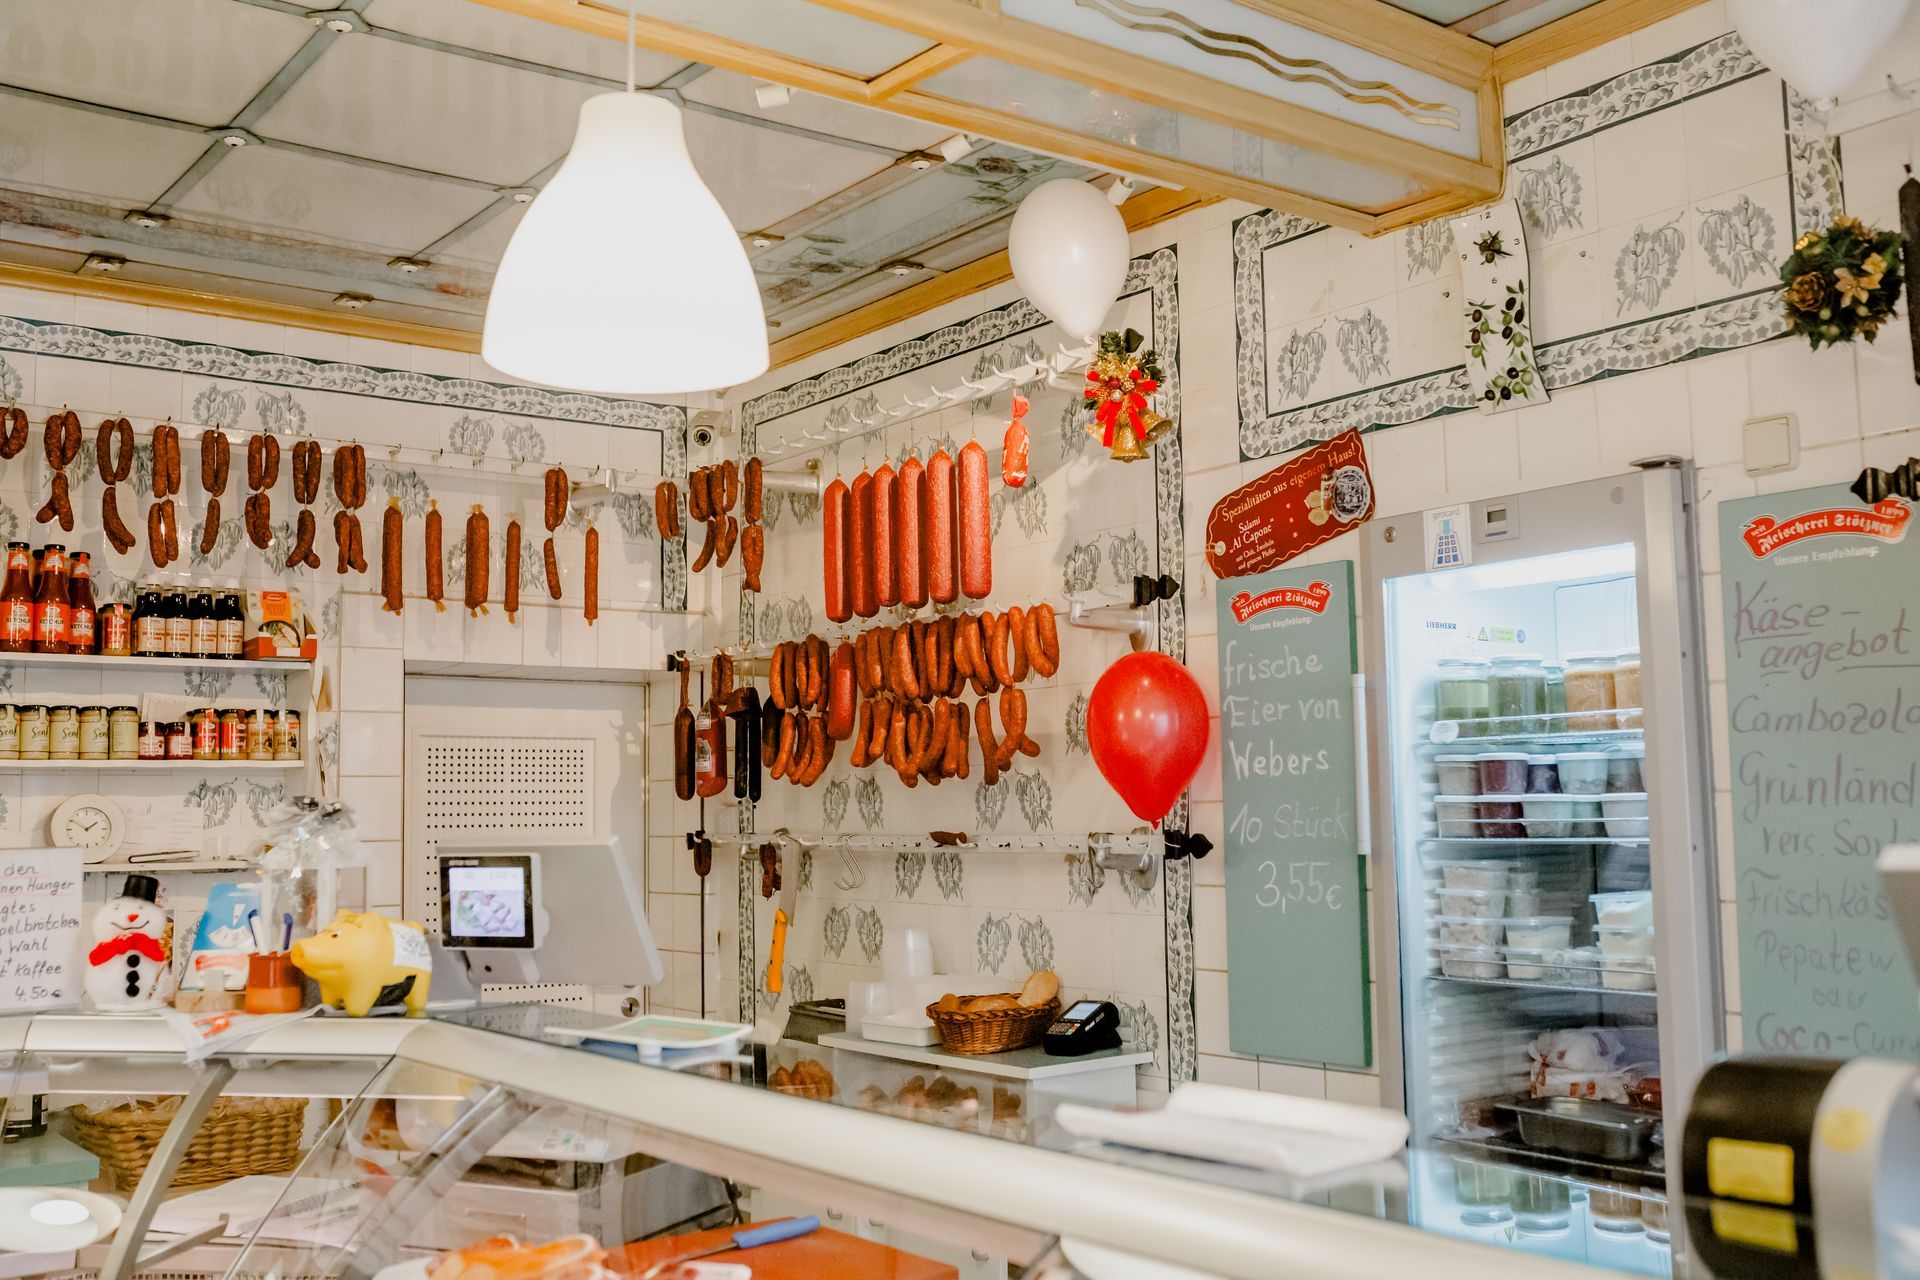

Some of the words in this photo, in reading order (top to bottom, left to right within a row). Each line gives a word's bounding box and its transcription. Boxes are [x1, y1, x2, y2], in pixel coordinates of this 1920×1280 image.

[1513, 238, 1520, 246] 3
[1221, 490, 1272, 523] Spezialitäten
[1273, 481, 1288, 494] aus
[1289, 463, 1326, 488] eigenem
[1327, 442, 1357, 468] Haus!
[1238, 516, 1261, 534] Salami
[1833, 512, 1895, 536] Stötzner
[1774, 554, 1809, 567] Unsere
[1812, 545, 1880, 561] Empfehlung:
[1285, 591, 1321, 608] Stötzner
[1426, 620, 1457, 630] LIEBHERR
[1760, 607, 1912, 680] angebot
[1223, 640, 1324, 689] frische
[1223, 695, 1292, 728] Eier
[1298, 698, 1342, 722] von
[1228, 738, 1329, 781] Webers
[1230, 803, 1263, 845] 10
[1273, 797, 1350, 840] Stück
[4, 864, 39, 877] den
[0, 880, 23, 894] nen
[27, 876, 75, 896] Hunger
[9, 937, 48, 954] Wahl
[15, 960, 63, 980] Kaffee
